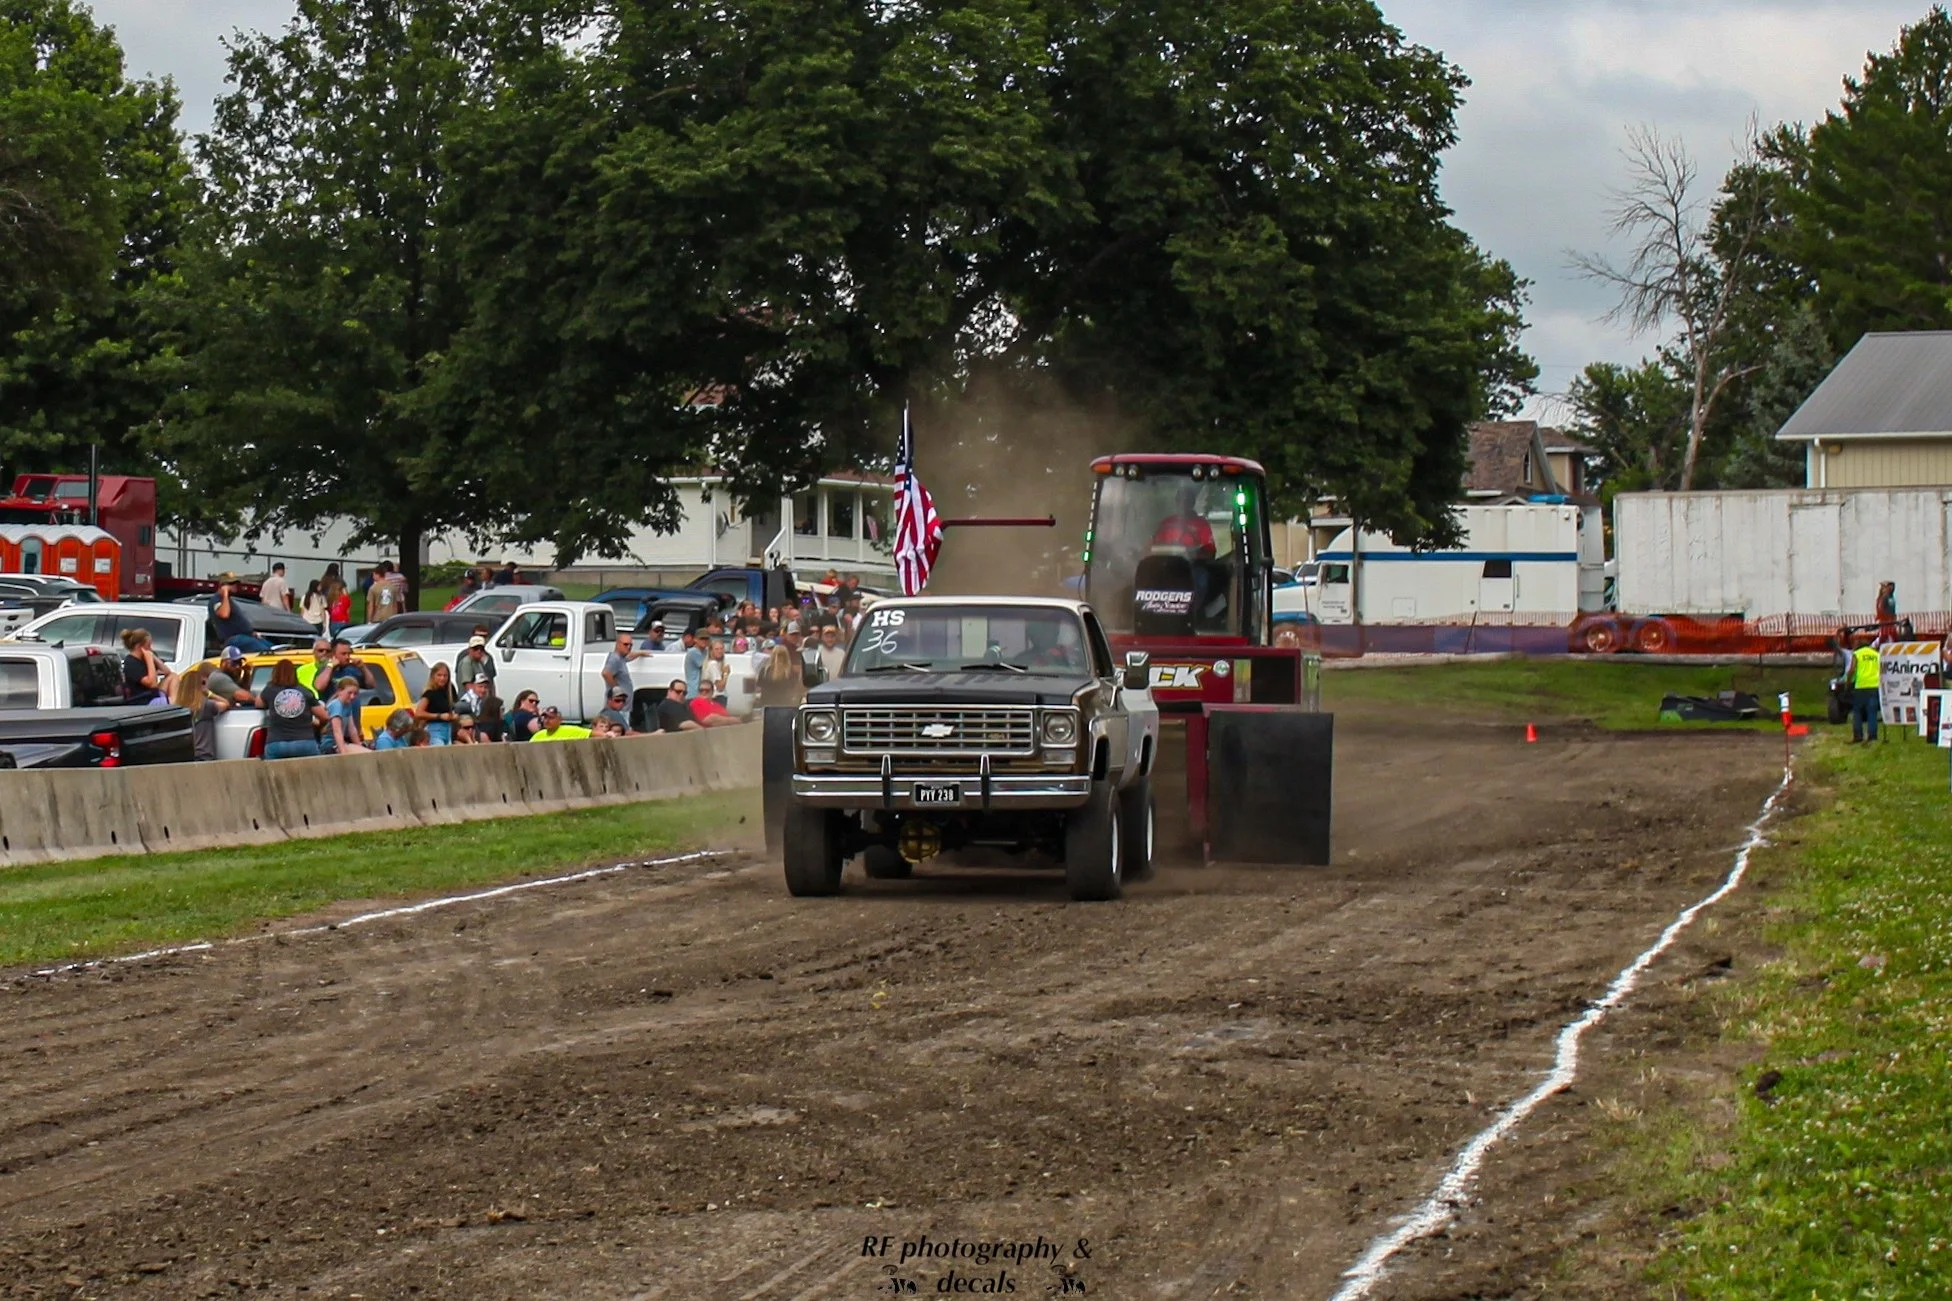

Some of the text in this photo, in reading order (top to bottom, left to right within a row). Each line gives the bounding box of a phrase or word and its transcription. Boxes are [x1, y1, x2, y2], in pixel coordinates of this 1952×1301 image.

[1135, 590, 1192, 602] RODGERS
[871, 610, 905, 627] HS
[862, 629, 899, 654] 36
